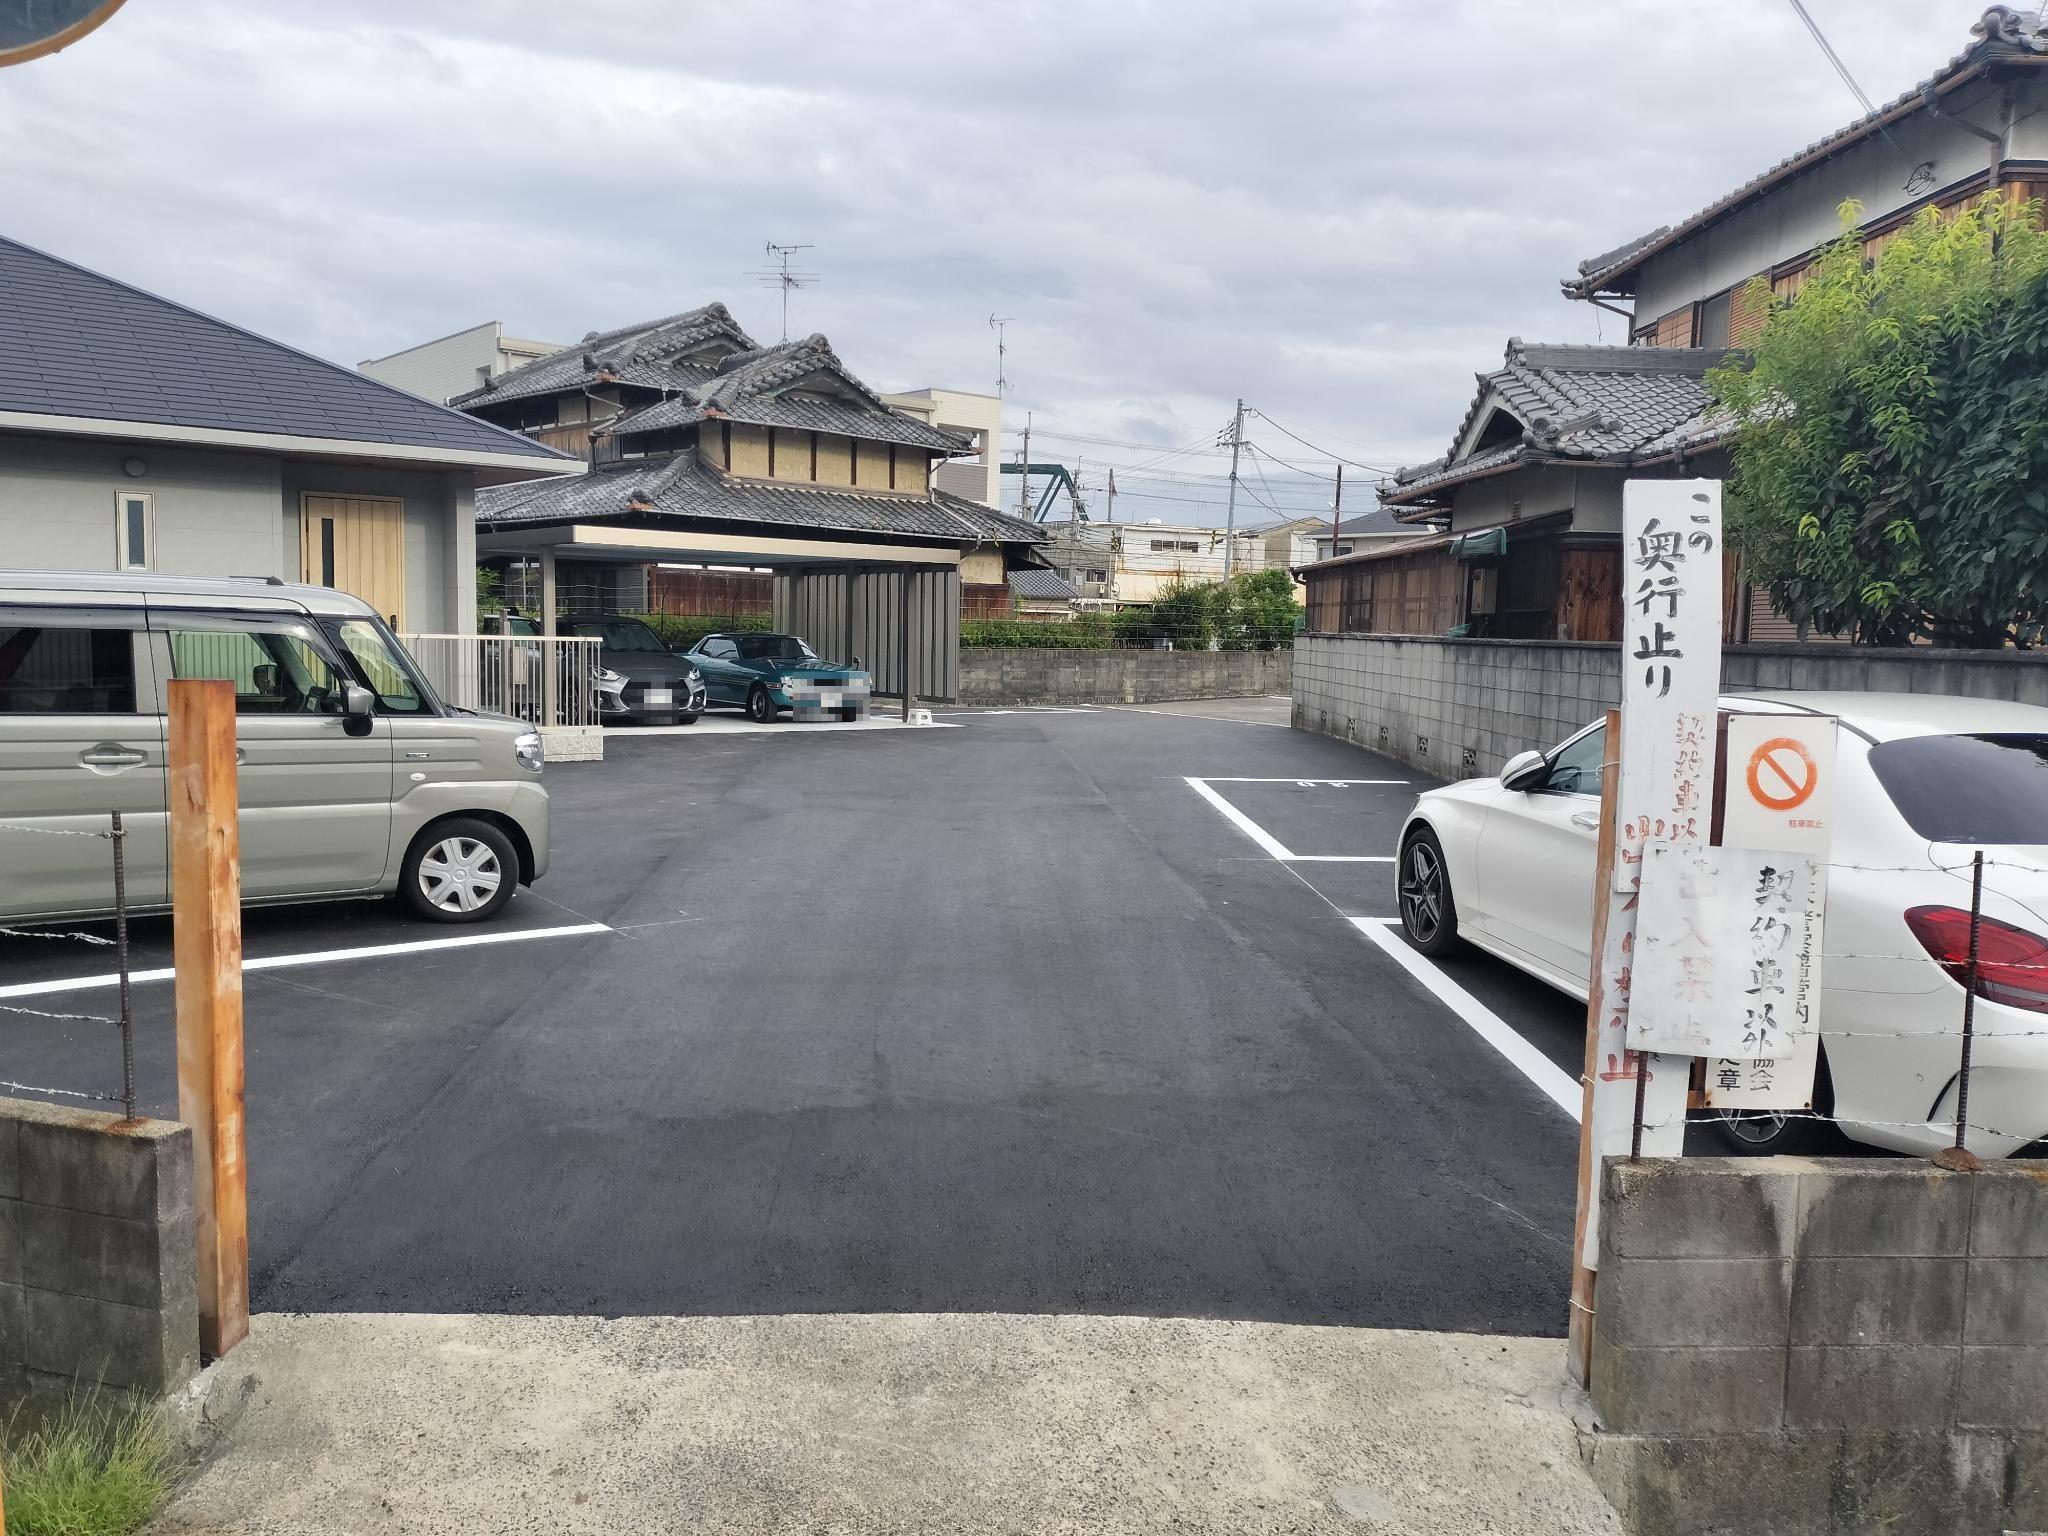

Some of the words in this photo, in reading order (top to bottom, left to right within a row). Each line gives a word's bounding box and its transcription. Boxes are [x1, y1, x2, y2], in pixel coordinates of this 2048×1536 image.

[1632, 517, 1687, 698] 奥行止り
[1688, 492, 1713, 554] この
[1742, 865, 1795, 1057] 契約車以外
